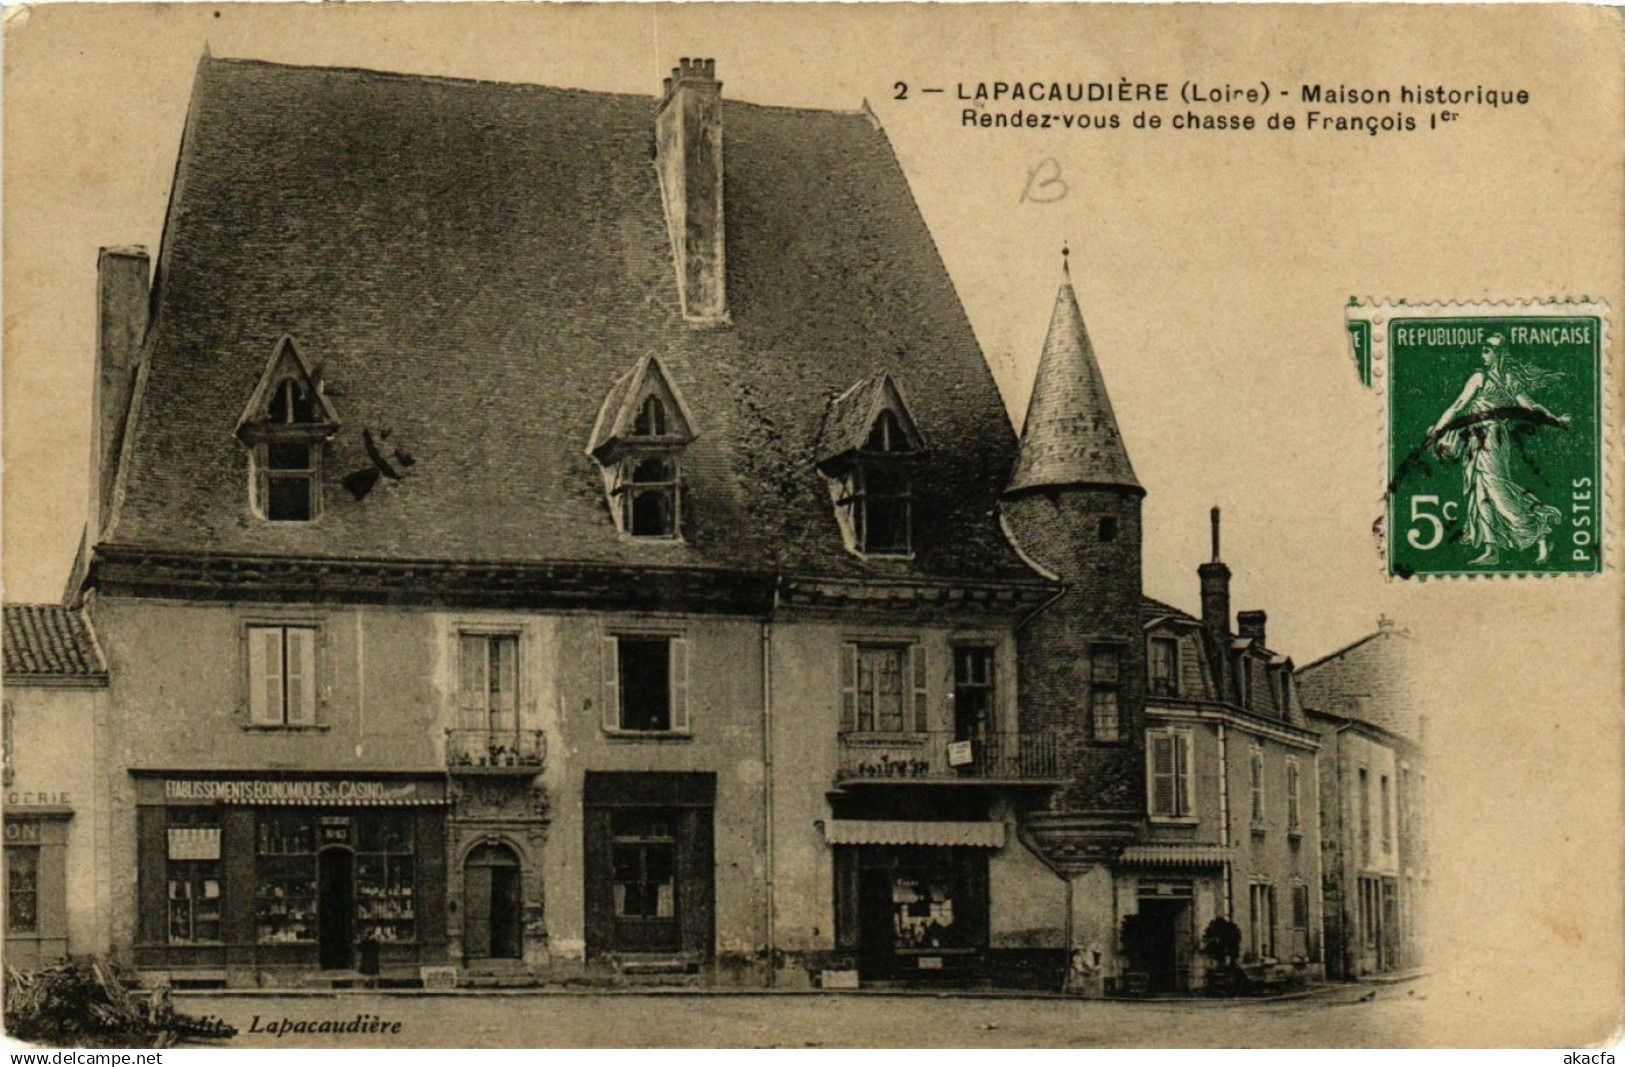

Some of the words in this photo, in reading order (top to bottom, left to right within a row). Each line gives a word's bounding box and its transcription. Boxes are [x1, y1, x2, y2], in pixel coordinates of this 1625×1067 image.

[1397, 327, 1484, 348] REPUBLIQUE
[1511, 327, 1592, 347] FRANÇAISE
[1572, 476, 1592, 561] POSTES
[338, 780, 384, 799] CASINO
